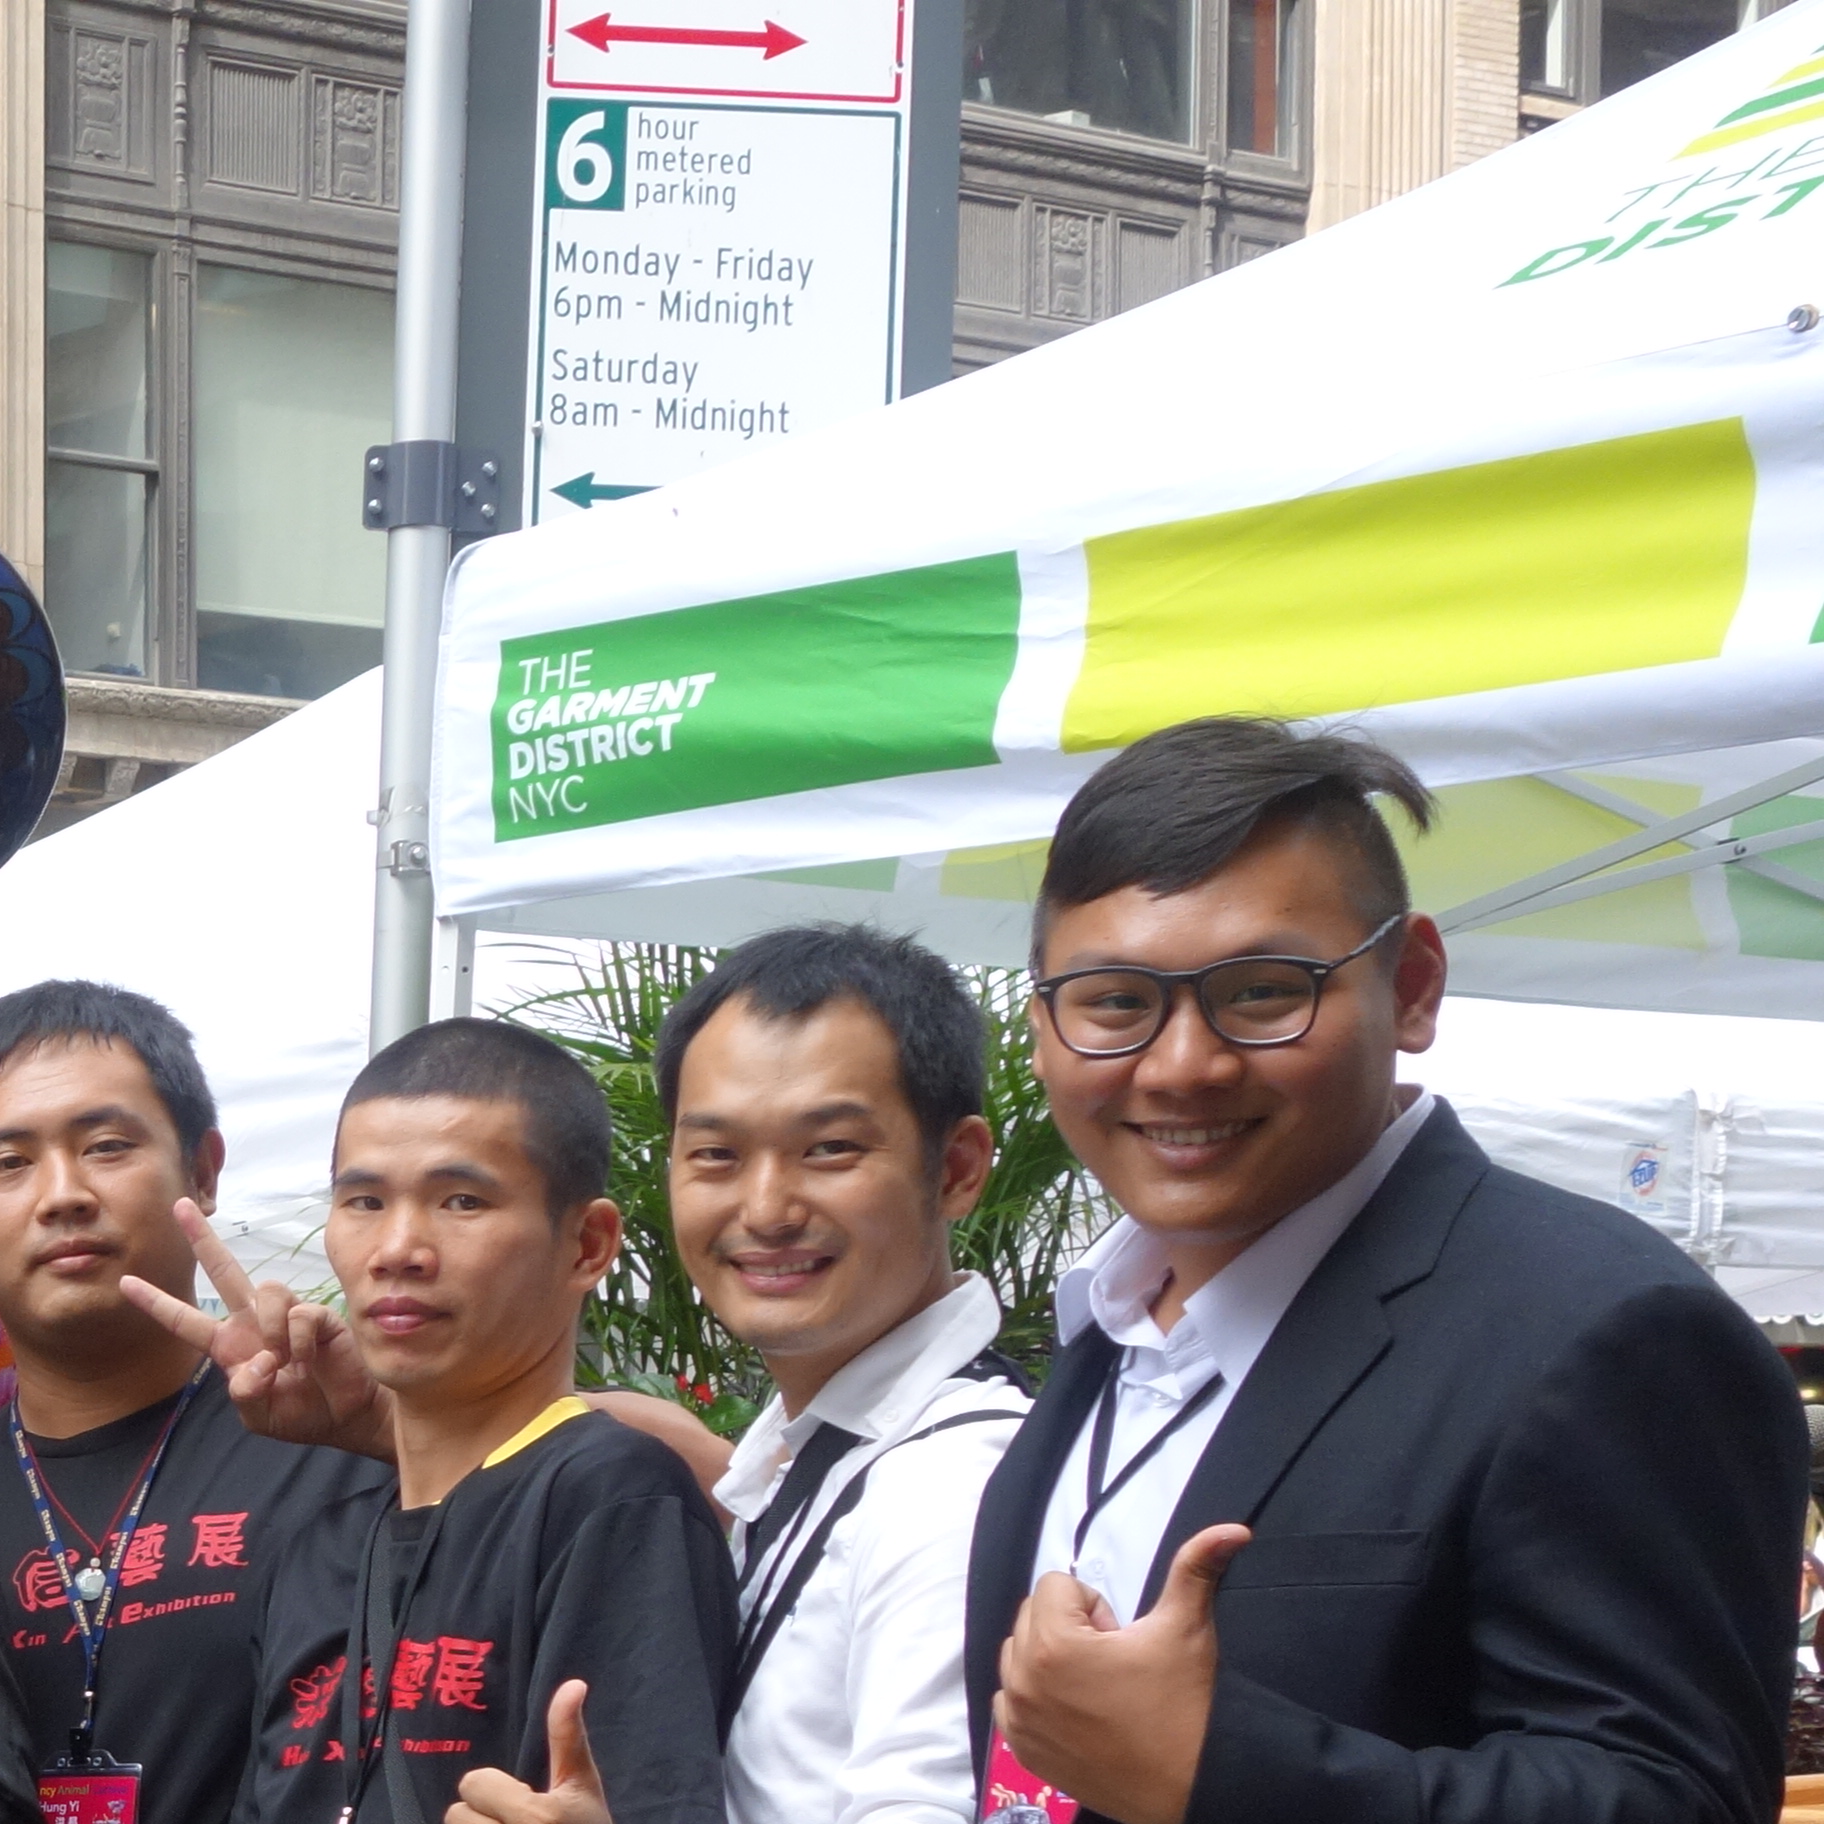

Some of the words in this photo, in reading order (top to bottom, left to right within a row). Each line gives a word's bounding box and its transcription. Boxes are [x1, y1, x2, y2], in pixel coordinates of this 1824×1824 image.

[638, 112, 699, 140] hour
[557, 111, 613, 202] 6
[636, 146, 752, 175] metered
[635, 178, 736, 213] parking
[554, 241, 680, 285] Monday
[716, 247, 813, 290] Friday
[554, 286, 622, 325] 6pm
[659, 290, 793, 332] Midnight
[551, 349, 698, 393] Saturday
[550, 393, 618, 427] 8am
[655, 397, 790, 440] Midnight
[518, 649, 594, 695] THE
[507, 672, 717, 735] GARMENT
[509, 713, 683, 780] DISTRICT
[509, 775, 588, 823] NYC
